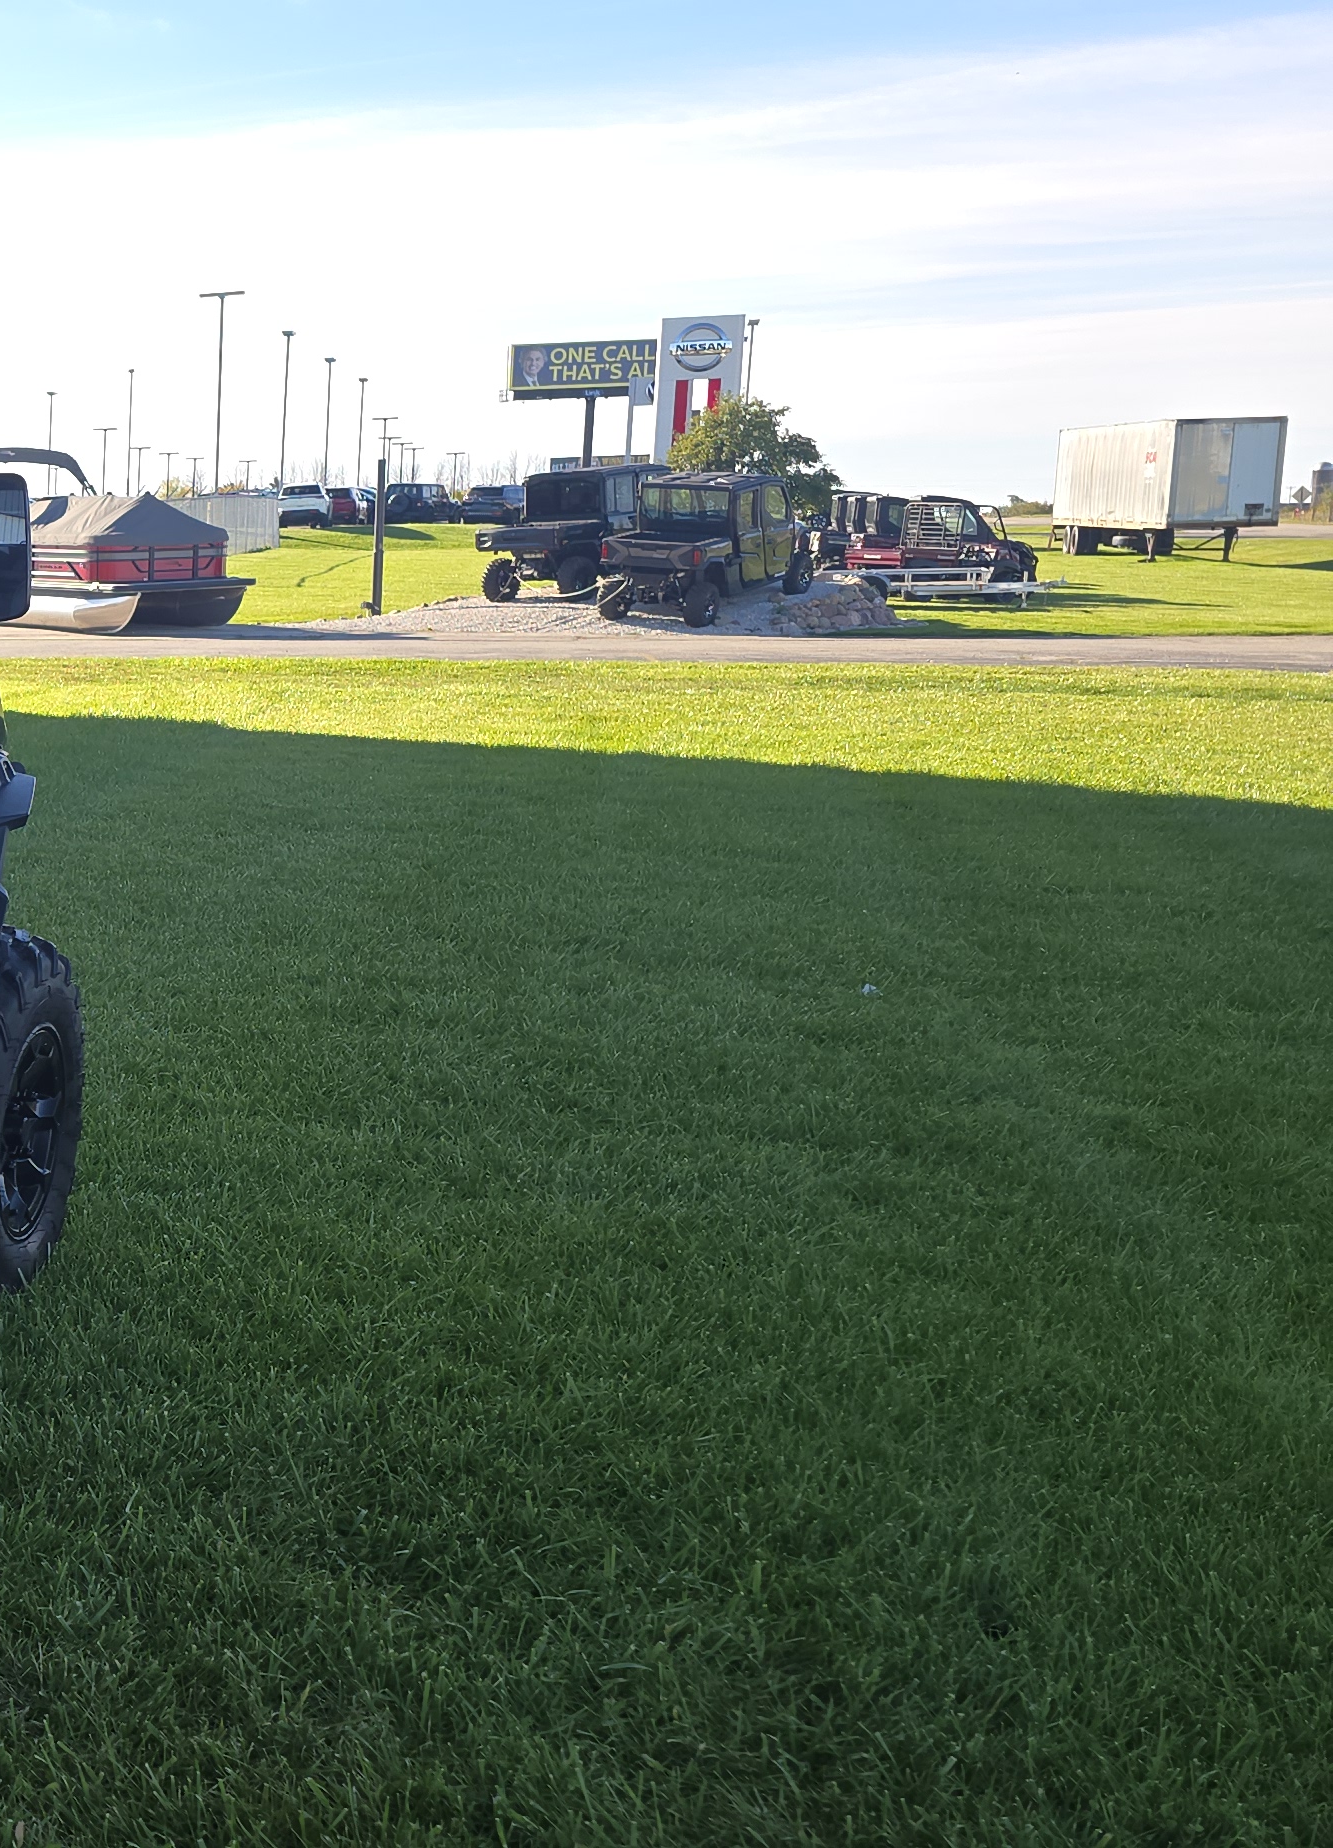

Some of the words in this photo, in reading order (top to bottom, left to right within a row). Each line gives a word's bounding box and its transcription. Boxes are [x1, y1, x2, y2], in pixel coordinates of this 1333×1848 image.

[550, 346, 597, 364] ONE
[602, 344, 655, 361] CALL
[675, 342, 726, 352] NISSAN
[549, 363, 622, 381] THAT'S
